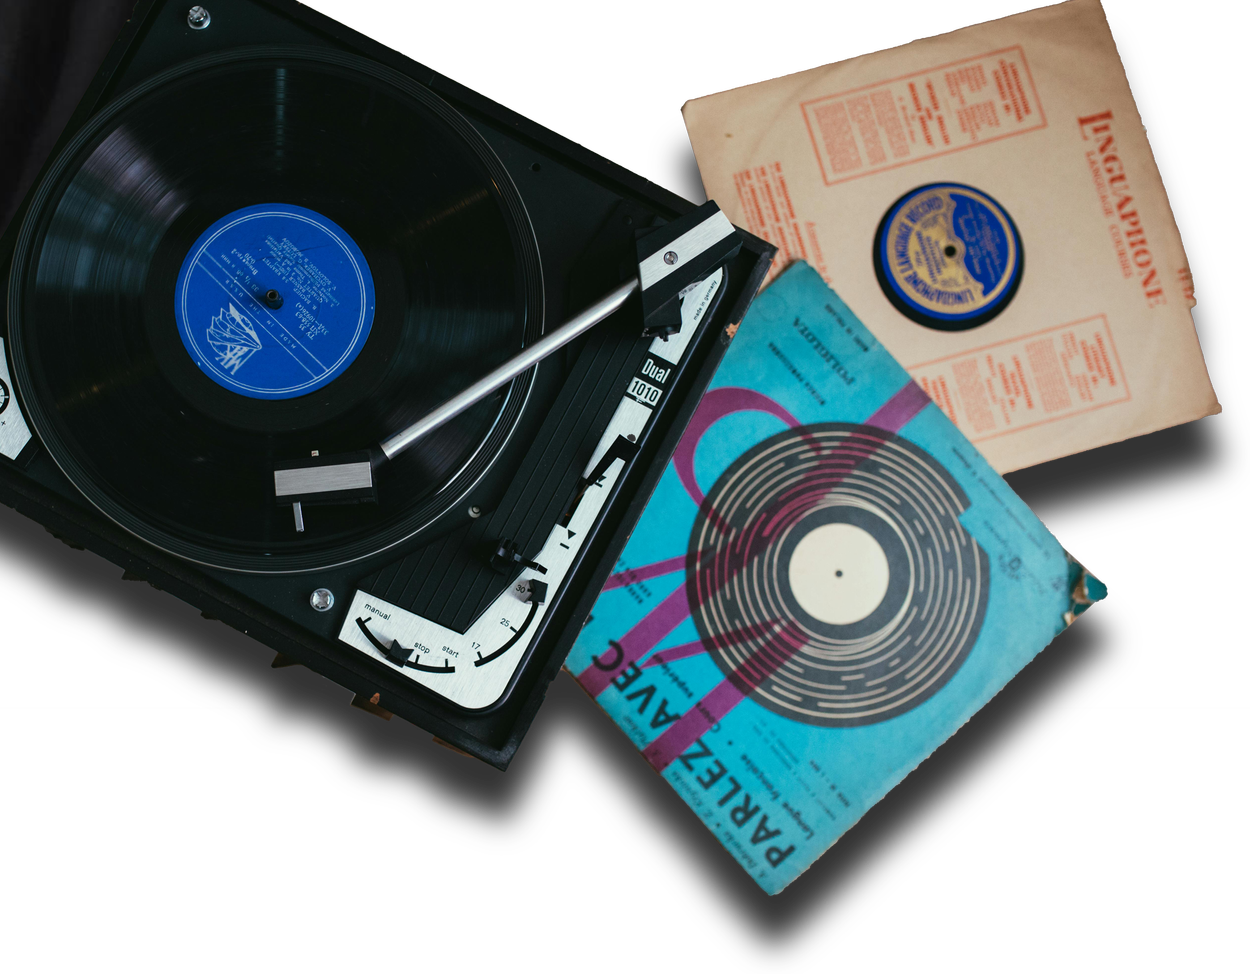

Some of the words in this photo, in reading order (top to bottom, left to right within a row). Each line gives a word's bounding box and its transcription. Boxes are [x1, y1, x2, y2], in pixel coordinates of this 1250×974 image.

[1086, 150, 1113, 218] LANGUAGE
[1109, 223, 1133, 278] COURSES
[894, 221, 913, 273] LANGUAGE
[251, 283, 259, 292] 33
[303, 283, 323, 303] QUARTET
[248, 302, 260, 314] THE
[692, 306, 702, 320] made
[702, 279, 718, 301] germany
[298, 322, 306, 330] 35
[279, 332, 296, 348] MADE
[790, 315, 855, 386] POLIGLOTA
[642, 359, 670, 382] Dual
[631, 380, 658, 401] 1010
[515, 584, 525, 593] 30
[363, 602, 391, 620] manual
[499, 617, 510, 627] 25
[413, 640, 430, 654] stop
[441, 643, 459, 657] start
[471, 641, 480, 650] 17
[591, 639, 681, 734] AVEC
[647, 651, 694, 701] supérieur
[691, 701, 722, 733] Cours
[737, 753, 781, 800] française
[678, 739, 796, 866] PARLEZ
[779, 798, 817, 839] Langue
